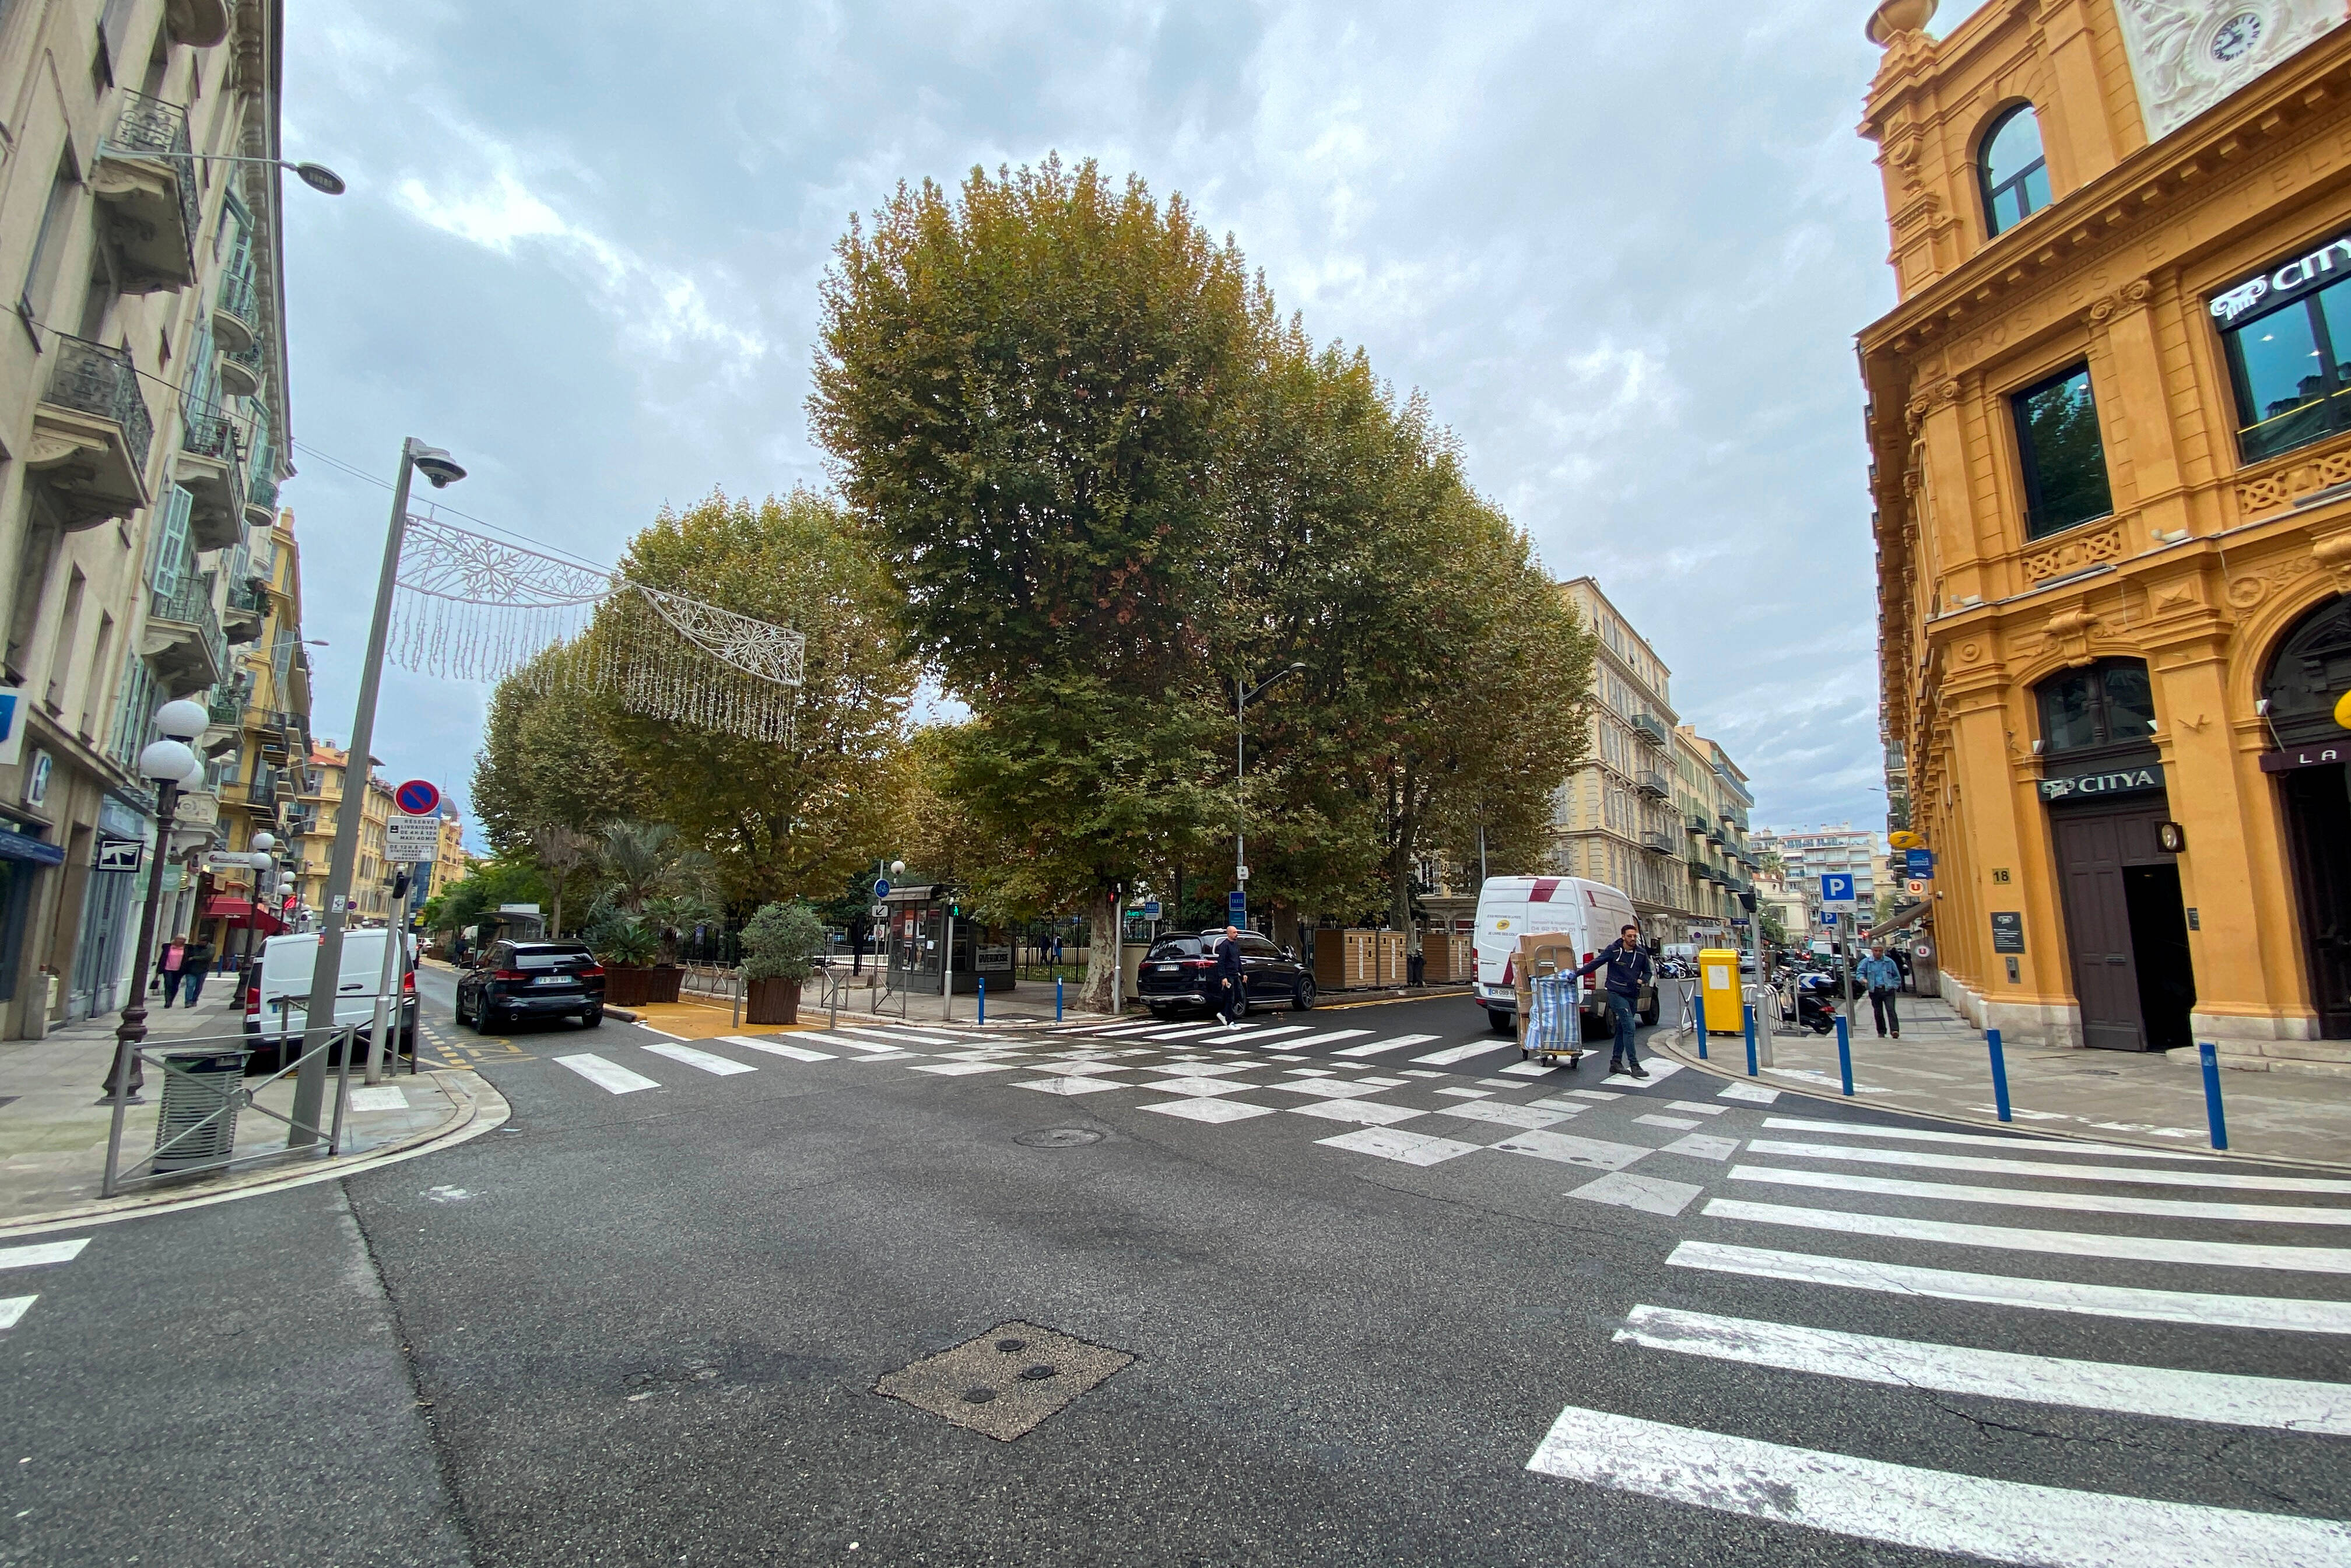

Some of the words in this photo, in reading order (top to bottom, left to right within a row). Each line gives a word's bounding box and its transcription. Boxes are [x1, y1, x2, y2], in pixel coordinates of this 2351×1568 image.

[2300, 750, 2336, 763] LA
[2079, 770, 2155, 792] CITYA
[1994, 871, 2009, 882] 18
[1829, 878, 1845, 896] P
[1824, 913, 1833, 922] P
